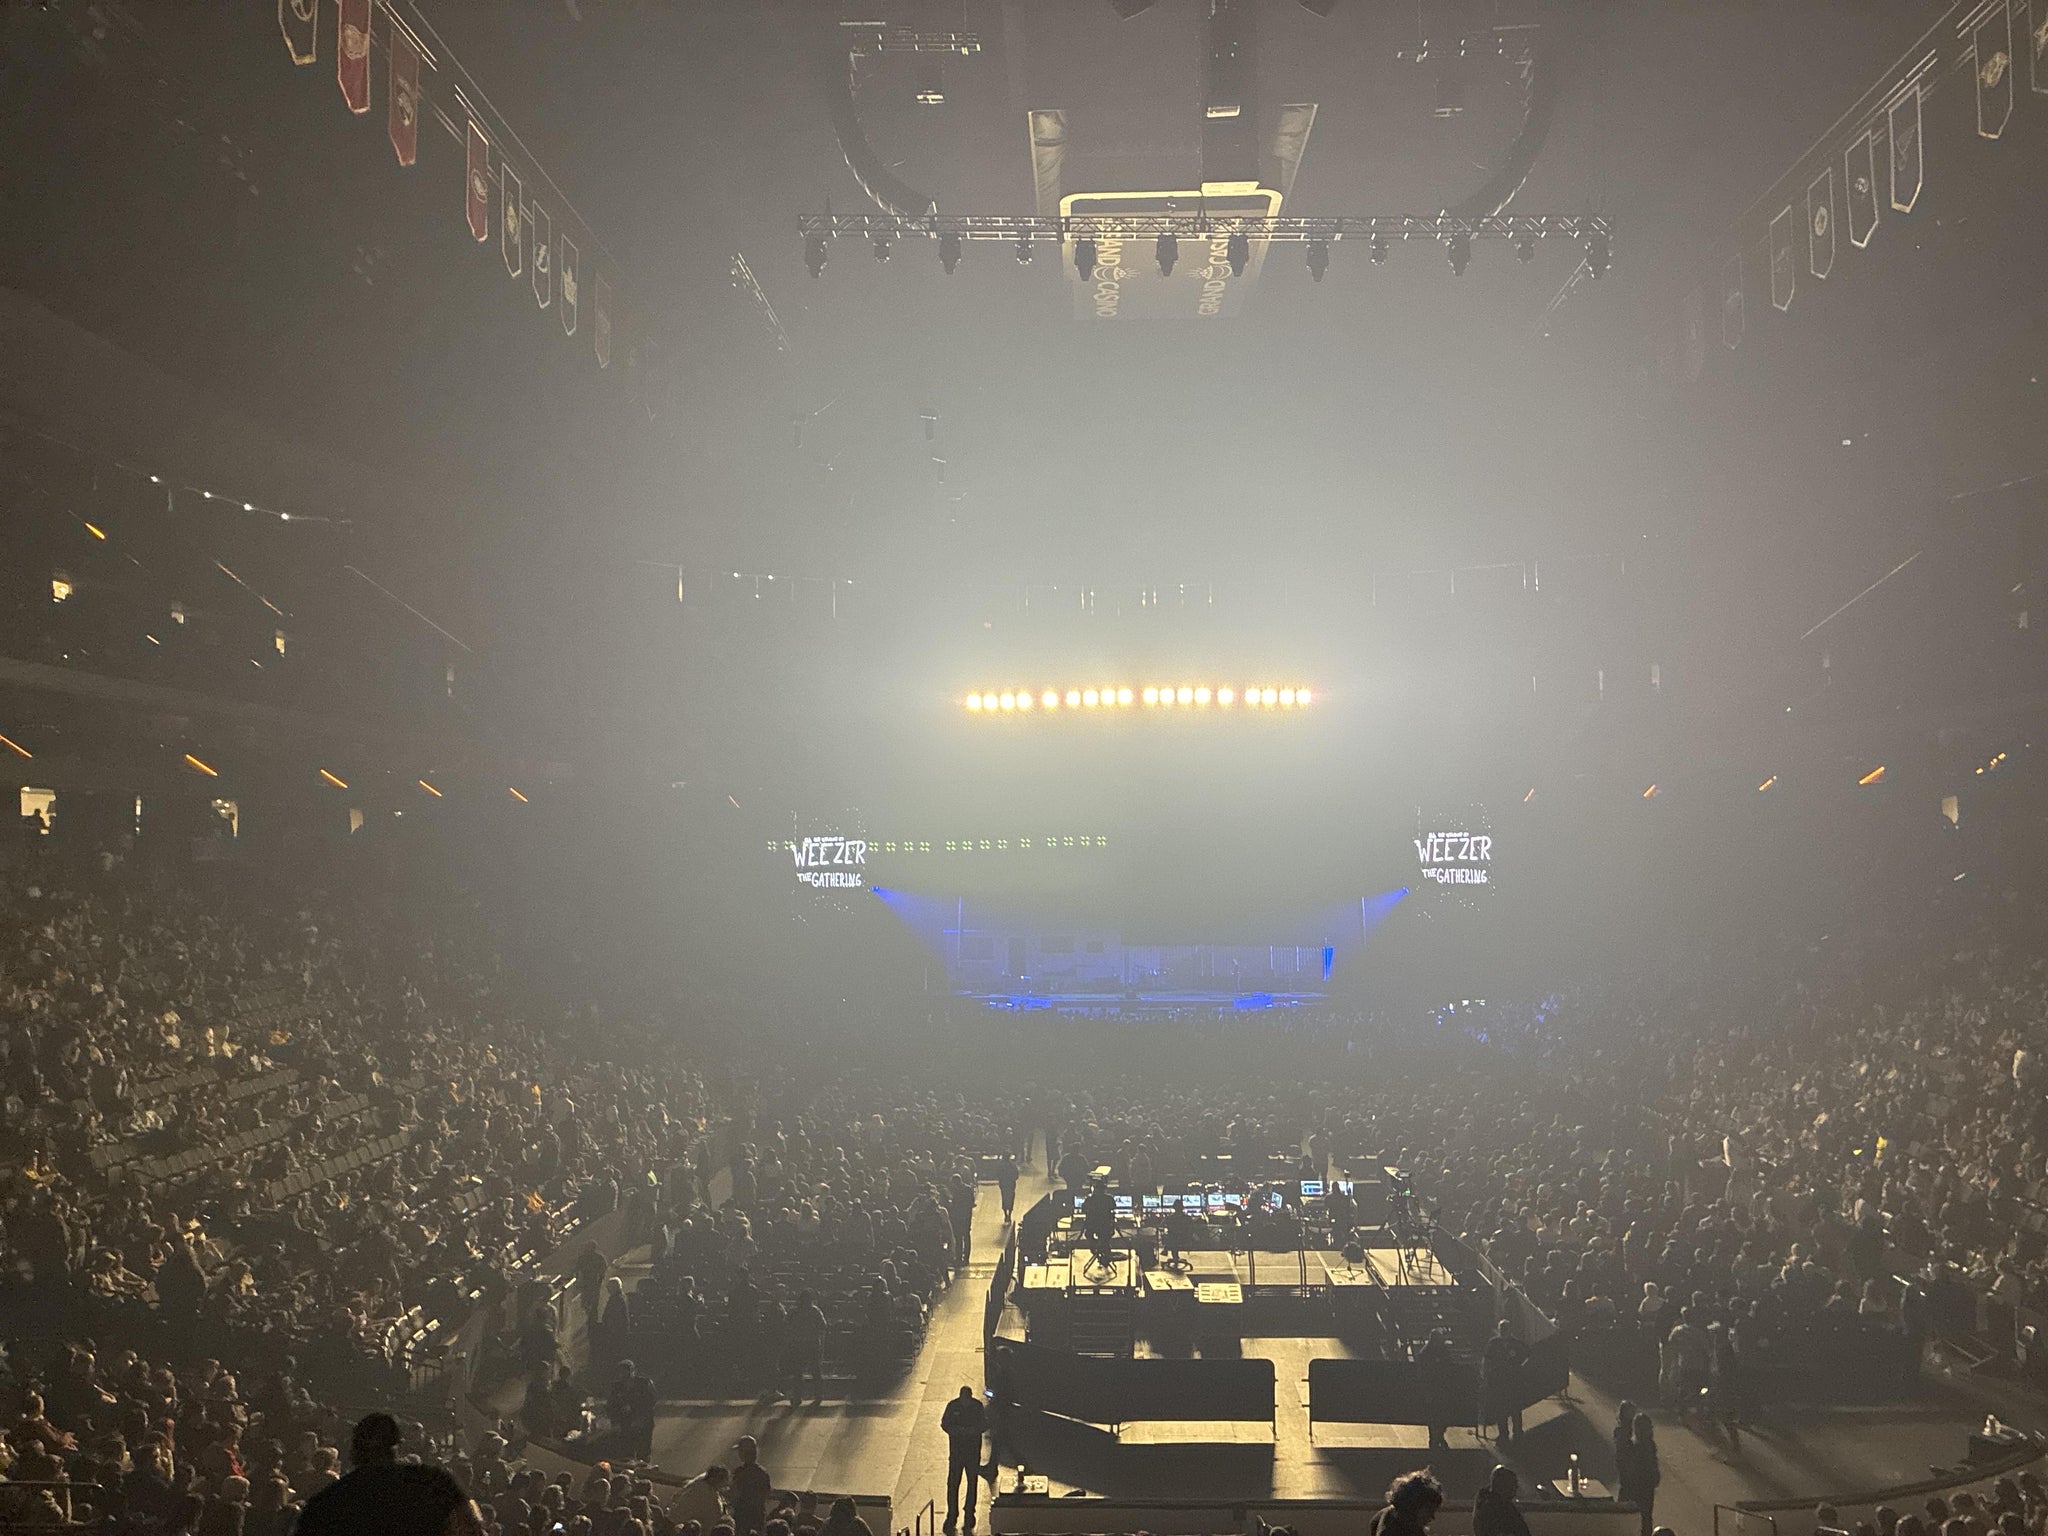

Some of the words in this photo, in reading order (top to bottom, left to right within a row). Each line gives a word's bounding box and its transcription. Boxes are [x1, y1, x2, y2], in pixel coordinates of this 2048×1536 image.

[1094, 281, 1119, 317] CASINO
[1198, 280, 1225, 315] GRAND
[790, 840, 866, 867] WEEZER
[1414, 836, 1491, 863] WEEZER
[797, 872, 812, 883] THE
[811, 872, 861, 888] GATHERING
[1422, 868, 1437, 879] THE
[1436, 868, 1487, 884] GATHERING
